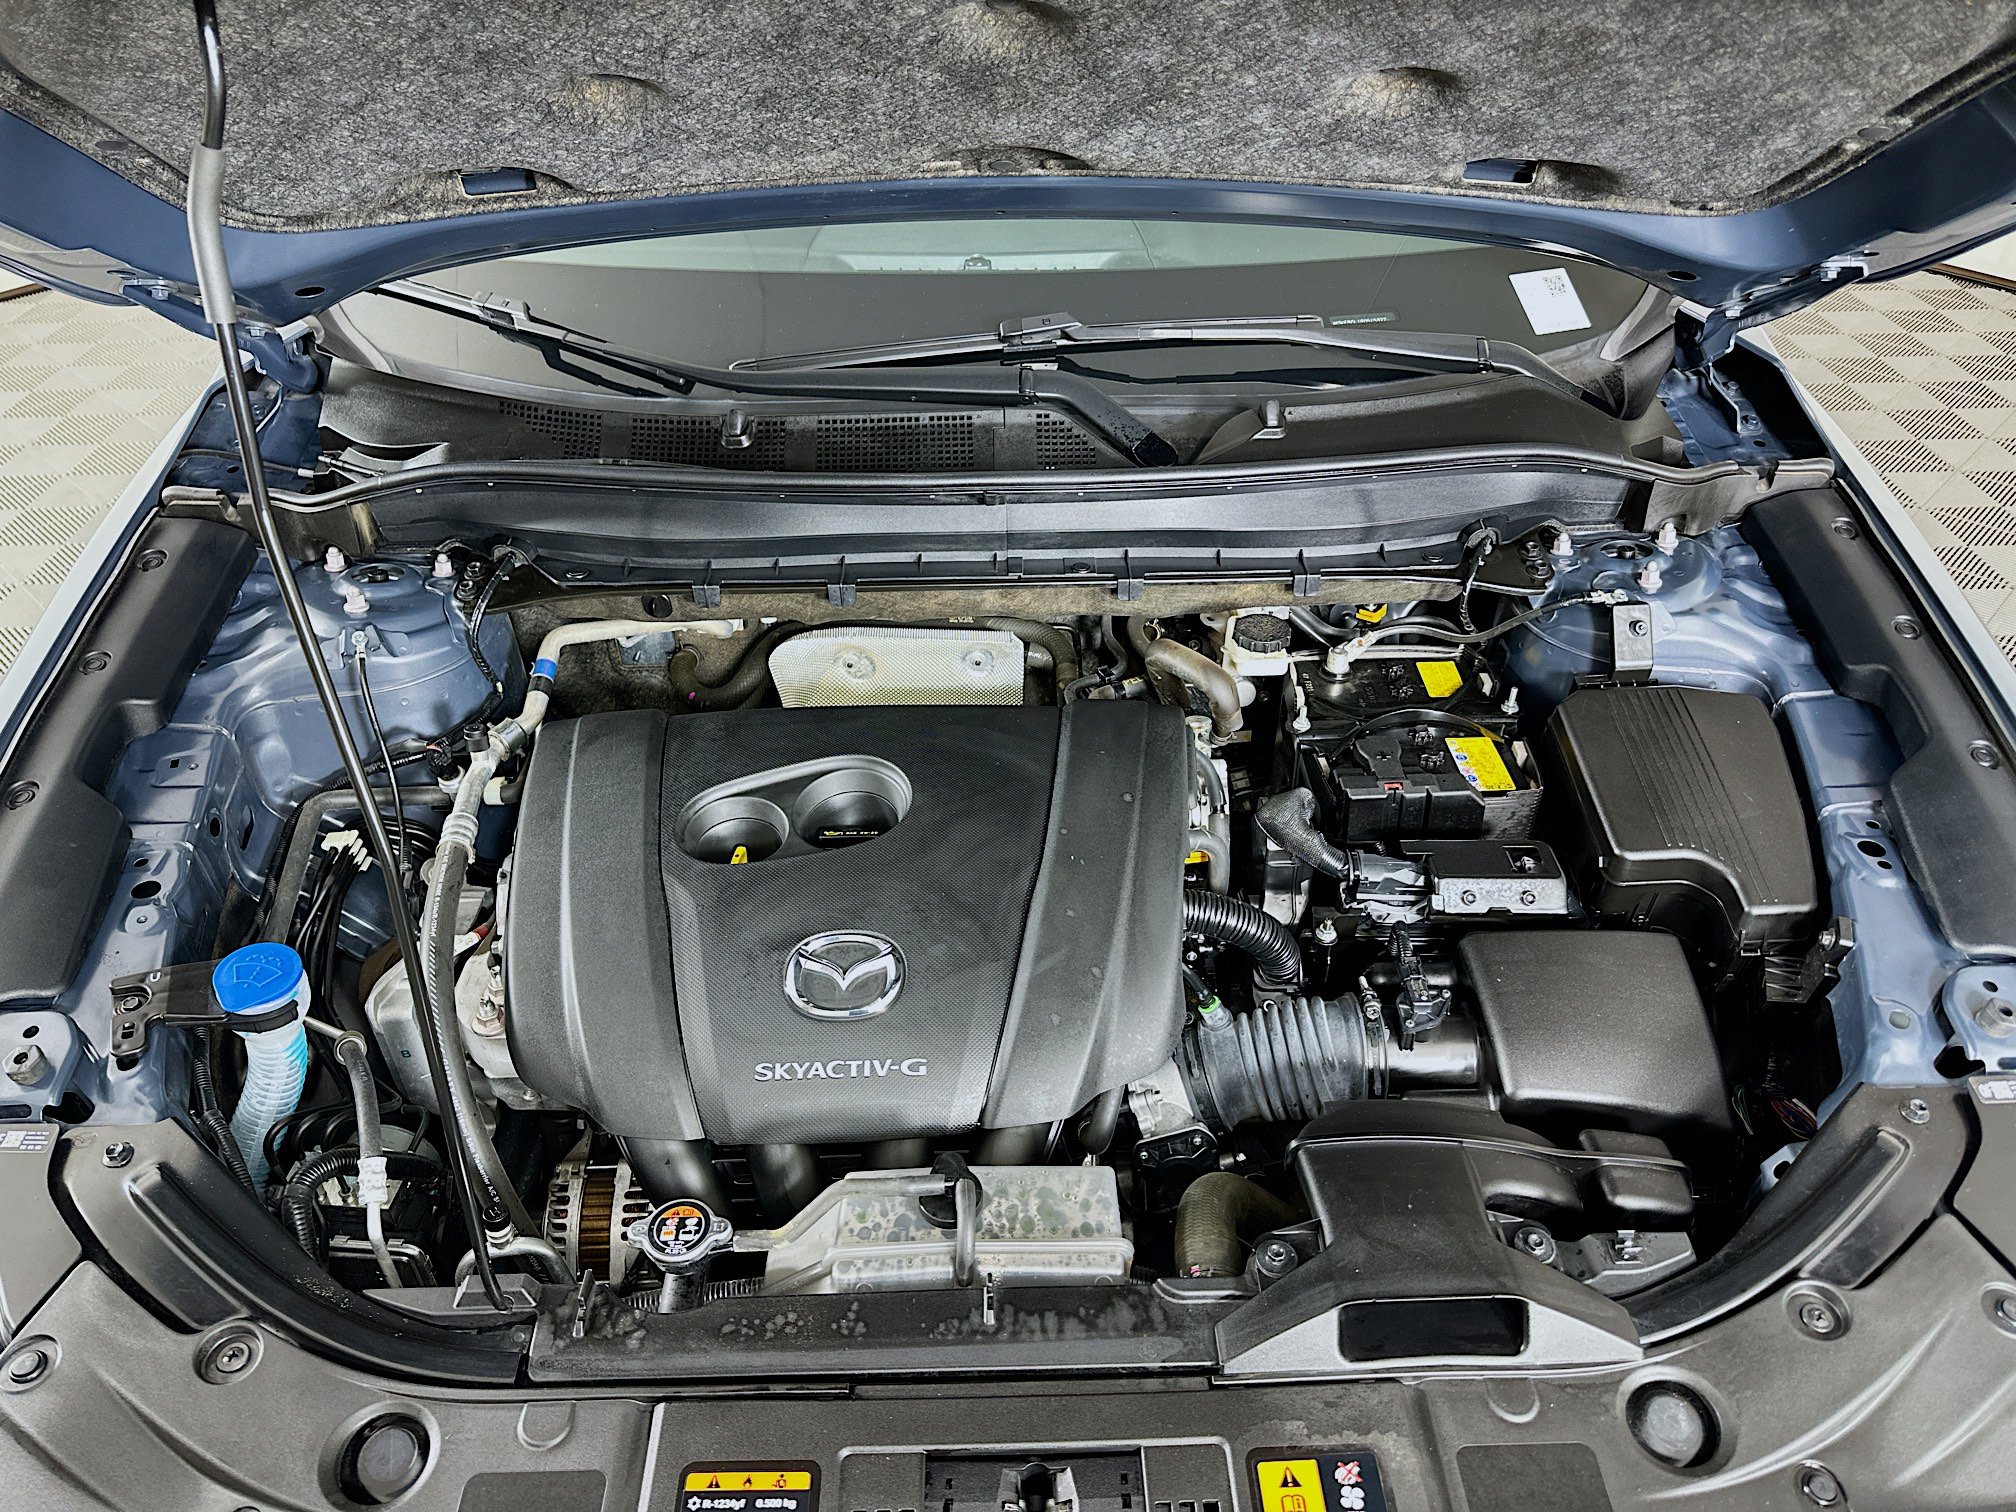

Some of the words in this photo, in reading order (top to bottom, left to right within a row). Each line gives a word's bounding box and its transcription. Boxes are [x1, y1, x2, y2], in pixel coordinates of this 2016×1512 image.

[754, 1057, 929, 1082] SKYACTIV-G
[702, 1498, 747, 1511] R-1234yf
[783, 1498, 797, 1510] kg
